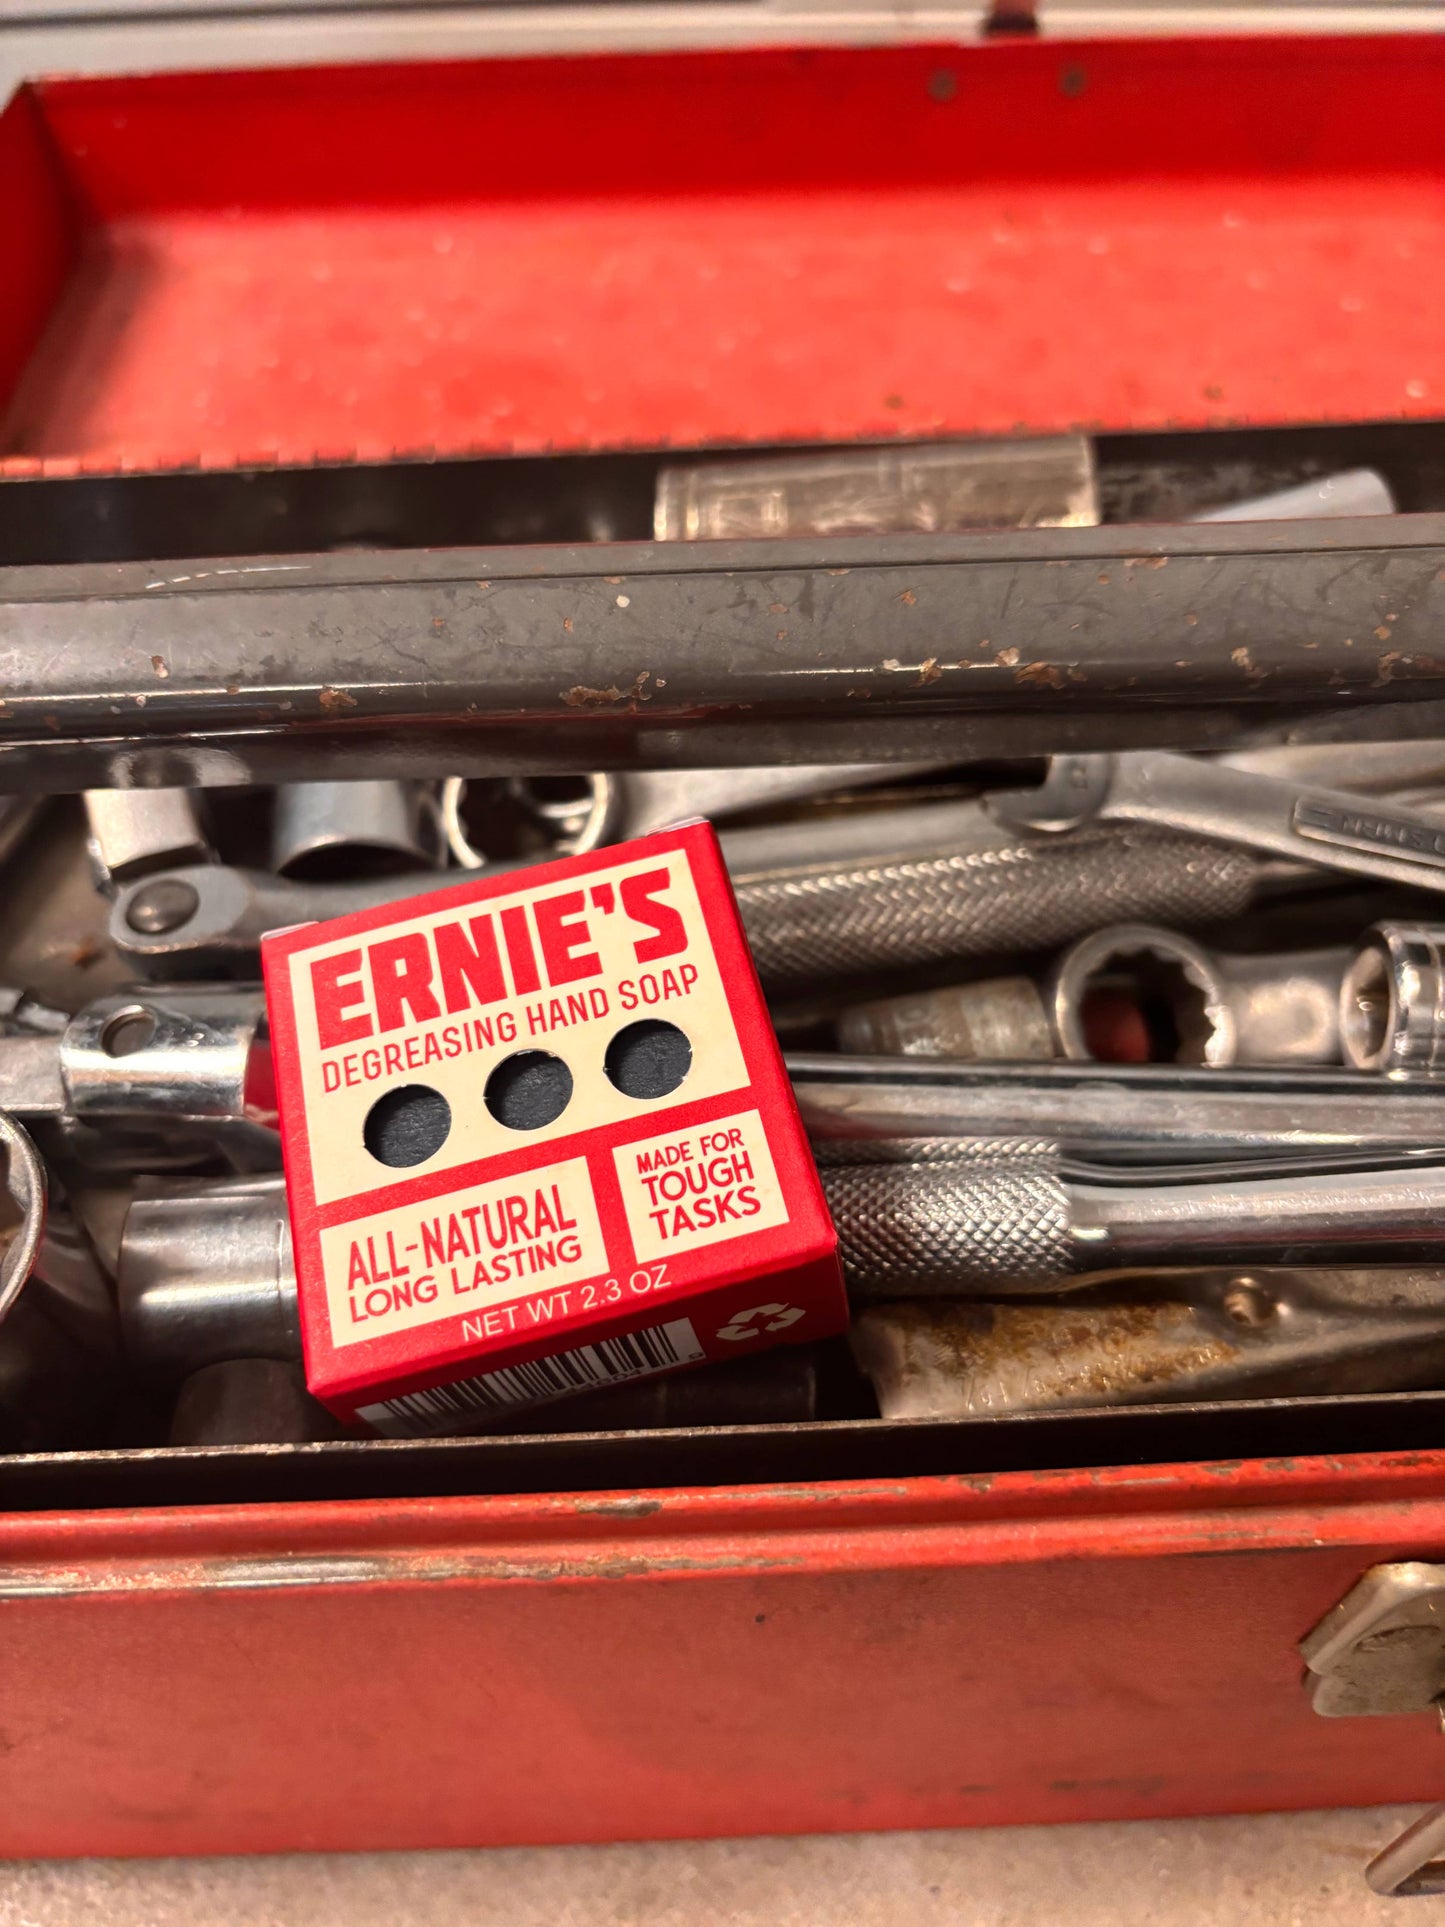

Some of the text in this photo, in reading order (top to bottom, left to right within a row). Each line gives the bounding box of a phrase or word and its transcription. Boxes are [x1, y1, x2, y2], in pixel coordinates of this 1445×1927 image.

[311, 868, 688, 1050] ERNIE'S
[323, 964, 698, 1092] DEGREASING HAND SOAP
[637, 1129, 744, 1174] MADE FOR
[641, 1151, 754, 1206] TOUGH
[349, 1185, 577, 1290] ALL-NATURAL
[649, 1186, 760, 1239] TASKS
[350, 1236, 581, 1322] LONG LASTING
[461, 1263, 672, 1342] NET WT 2.3 OZ
